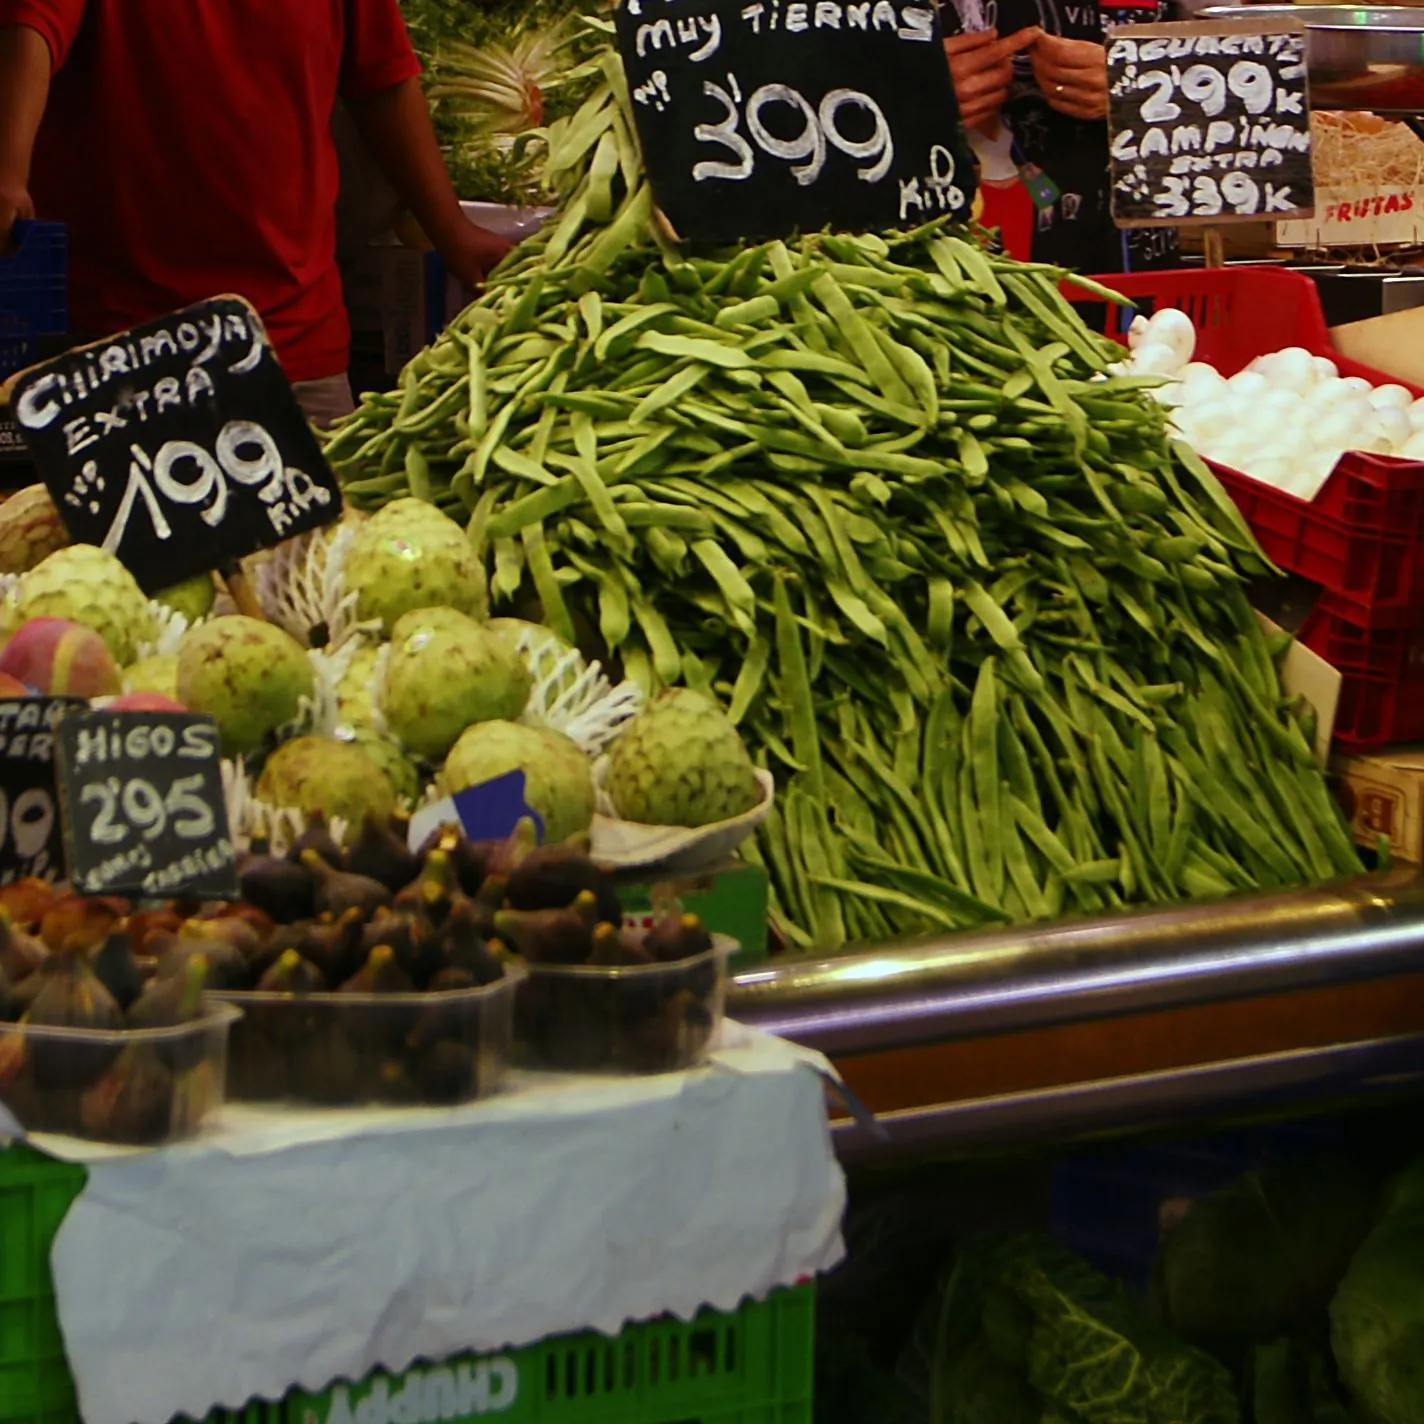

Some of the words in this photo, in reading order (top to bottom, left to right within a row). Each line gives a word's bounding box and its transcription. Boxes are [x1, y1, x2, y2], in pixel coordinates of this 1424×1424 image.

[692, 72, 895, 186] 3'99
[1137, 60, 1274, 123] 2'99
[1276, 87, 1303, 115] K
[62, 365, 215, 456] EXTRA
[75, 718, 219, 765] HIGOS
